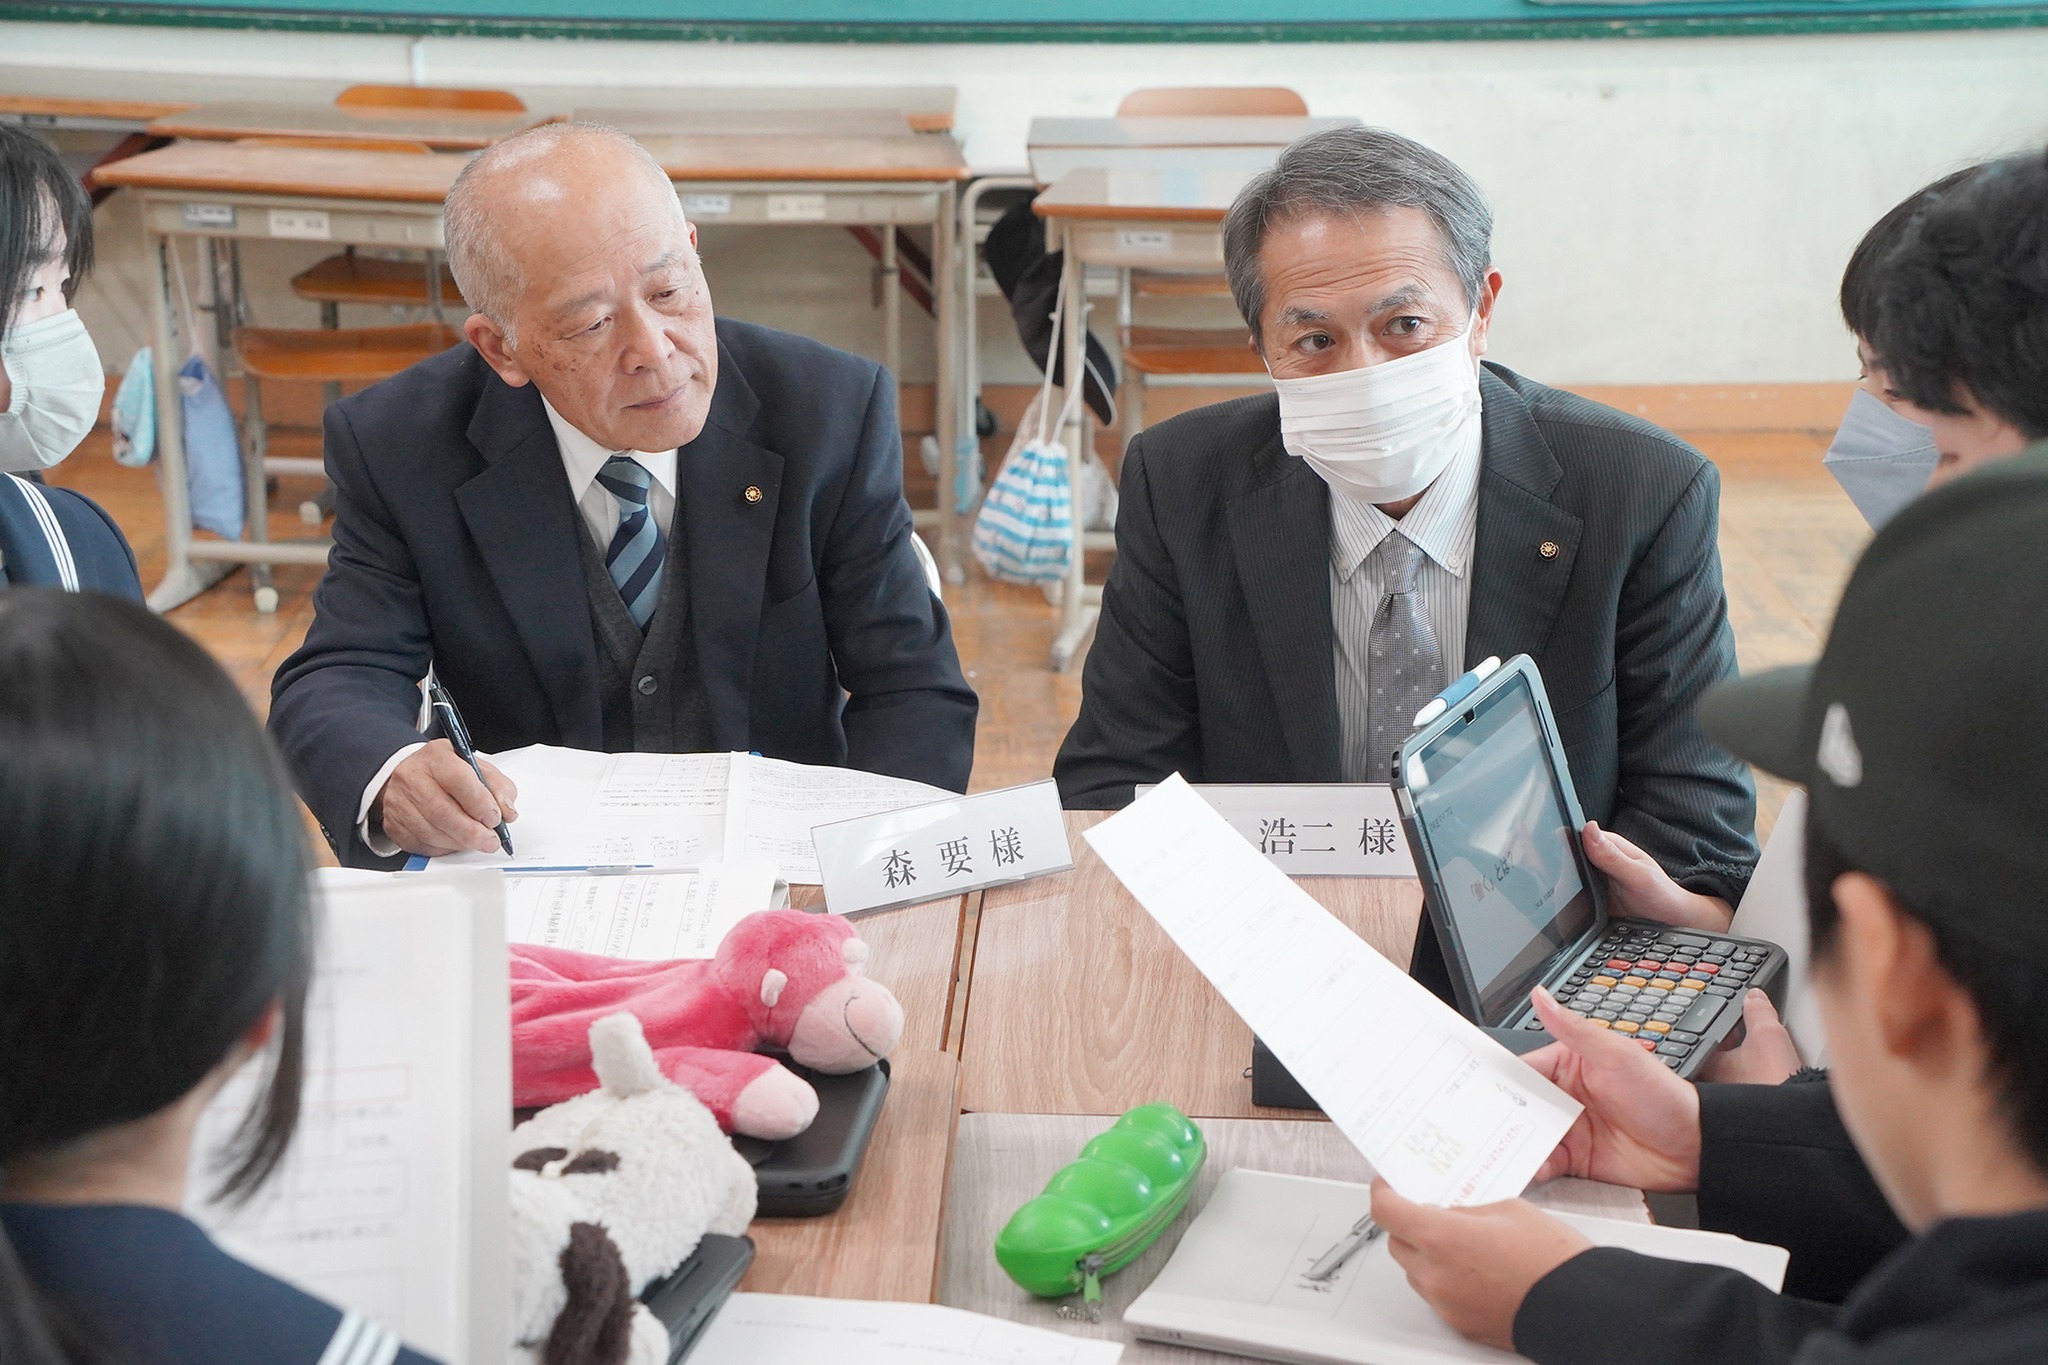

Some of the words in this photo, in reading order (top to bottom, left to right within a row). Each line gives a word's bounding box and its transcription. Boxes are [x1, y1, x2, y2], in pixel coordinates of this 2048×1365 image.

[881, 849, 917, 889] 森
[936, 836, 973, 879] 要
[988, 826, 1024, 867] 様
[1259, 817, 1336, 855] 浩二
[1358, 818, 1396, 856] 様
